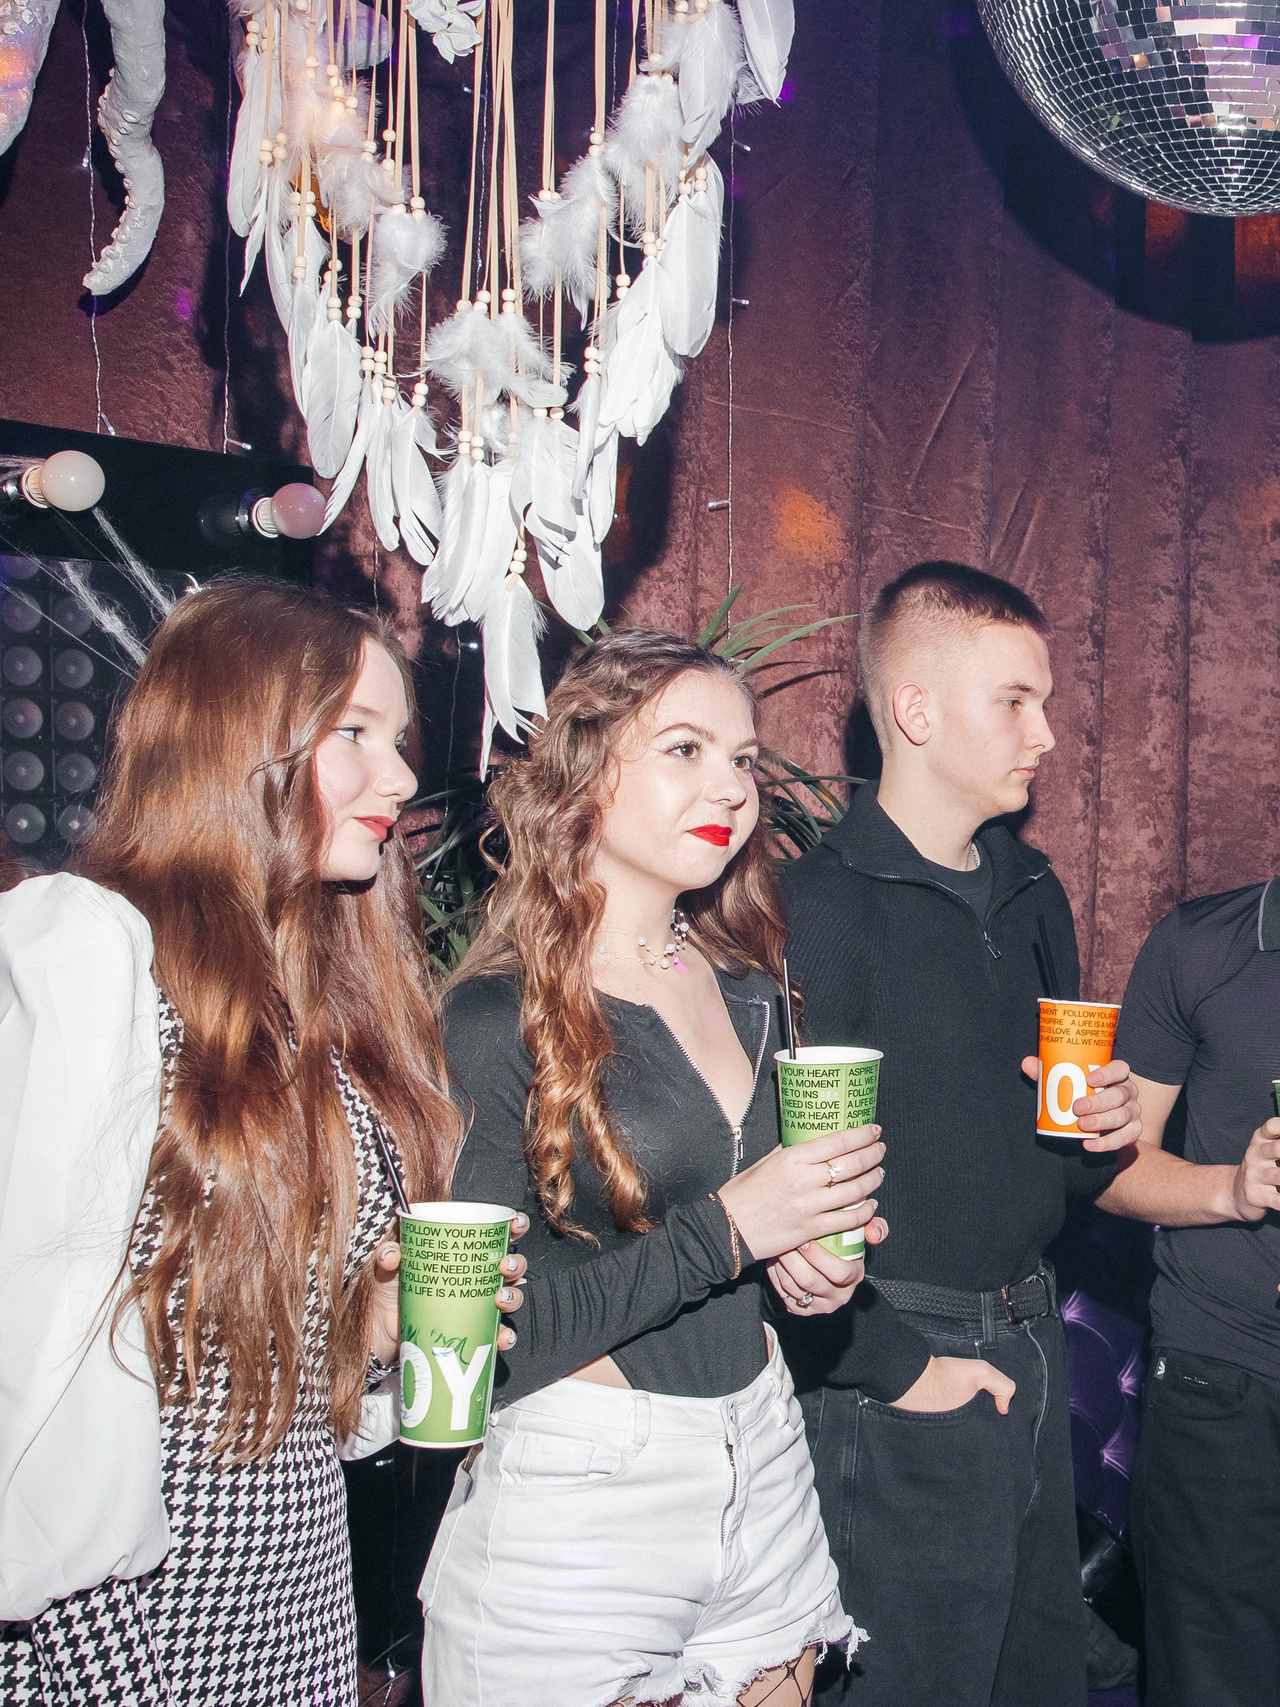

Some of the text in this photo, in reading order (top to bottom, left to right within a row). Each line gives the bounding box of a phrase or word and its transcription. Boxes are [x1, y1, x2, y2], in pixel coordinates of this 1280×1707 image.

[1063, 1010, 1096, 1018] FOLLOW
[1076, 1029, 1100, 1037] ASPIRE
[784, 1067, 840, 1077] YOUR HEART
[849, 1065, 873, 1076] ASPIRE
[796, 1080, 840, 1088] MOMENT
[848, 1076, 873, 1087] ALL WE
[803, 1090, 818, 1098] INS
[784, 1099, 840, 1109] NEED IS LOVE
[848, 1100, 853, 1108] A
[854, 1099, 868, 1108] LIFE
[786, 1110, 805, 1119] YOUR
[847, 1108, 871, 1118] ASPIRE
[798, 1122, 839, 1130] MOMENT
[406, 1224, 507, 1238] FOLLOW YOUR HEART
[416, 1238, 434, 1248] LIFE
[438, 1240, 448, 1249] IS
[464, 1238, 506, 1250] MOMENT
[415, 1249, 450, 1261] ASPIRE
[453, 1253, 468, 1262] TO
[472, 1253, 488, 1262] INS
[408, 1260, 500, 1274] ALL WE NEED IS LOV
[406, 1272, 500, 1286] FOLLOW YOUR HEART
[415, 1286, 433, 1296] LIFE
[436, 1289, 445, 1297] IS
[448, 1289, 456, 1297] A
